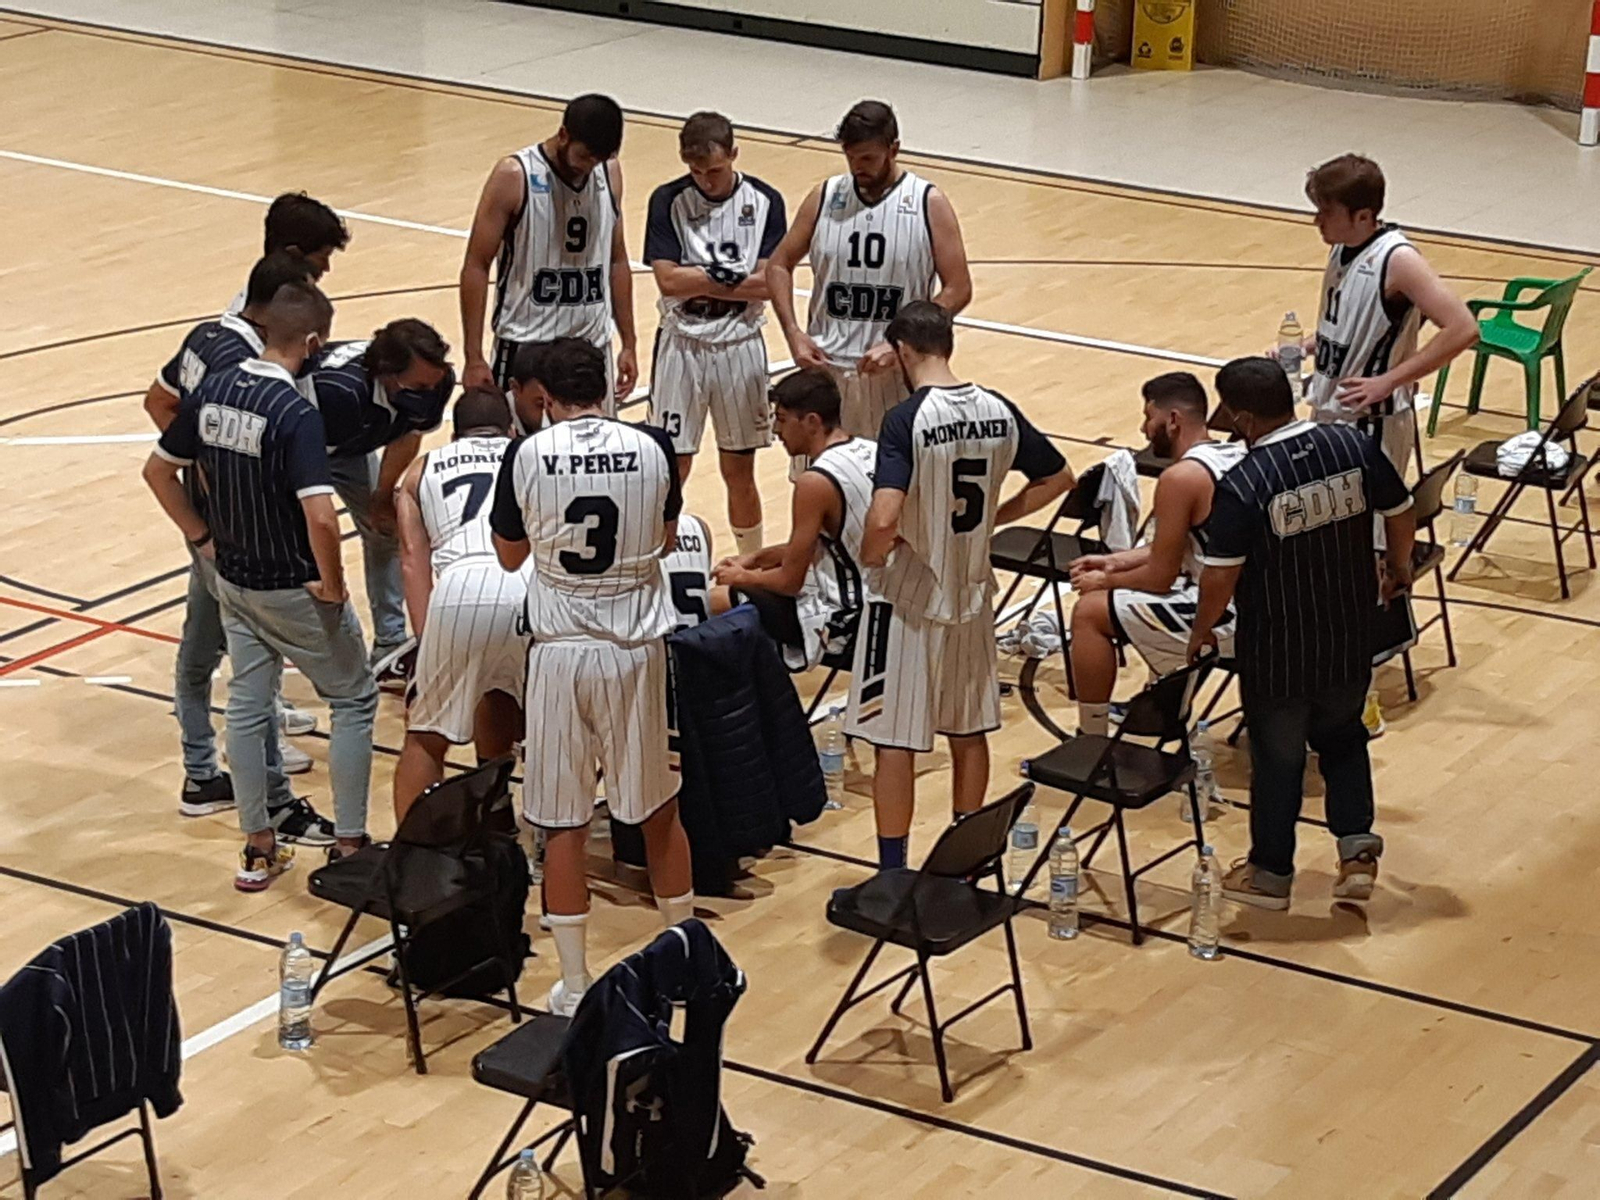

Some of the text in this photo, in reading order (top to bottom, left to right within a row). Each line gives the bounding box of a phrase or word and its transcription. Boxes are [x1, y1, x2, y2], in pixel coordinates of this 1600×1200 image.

[565, 216, 587, 253] 9
[847, 231, 886, 269] 10
[826, 282, 905, 322] CDH
[1325, 287, 1341, 325] 11
[199, 403, 267, 458] CDH
[662, 411, 681, 437] 13
[541, 454, 563, 475] V.
[442, 472, 494, 527] 7
[951, 458, 987, 534] 5
[1268, 468, 1366, 537] CDH
[559, 496, 619, 574] 3
